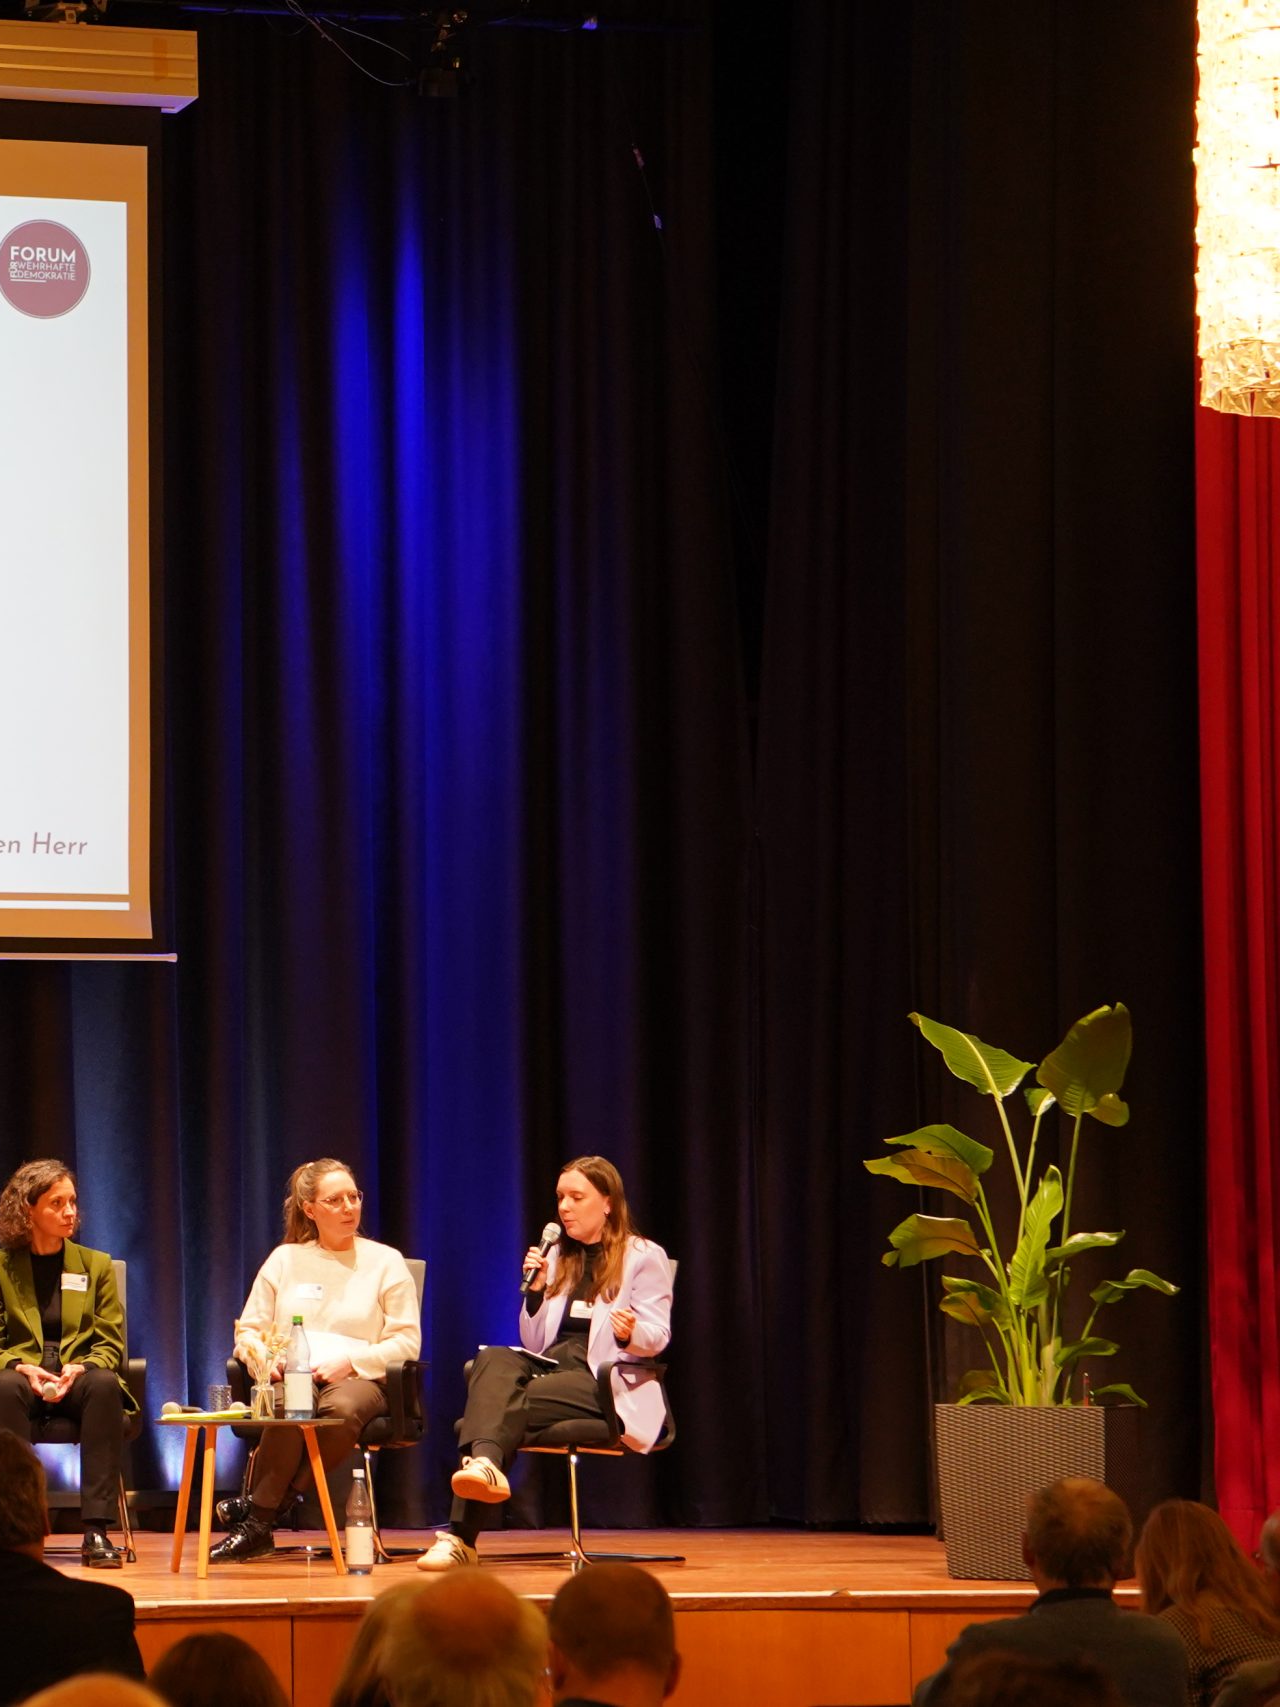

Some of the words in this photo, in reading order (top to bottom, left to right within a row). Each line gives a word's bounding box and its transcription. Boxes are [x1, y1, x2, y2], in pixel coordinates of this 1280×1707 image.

[10, 246, 76, 263] FORUM
[17, 261, 76, 273] WEHRHAFTE
[17, 270, 76, 281] DEMOKRATIE
[32, 831, 88, 855] Herr
